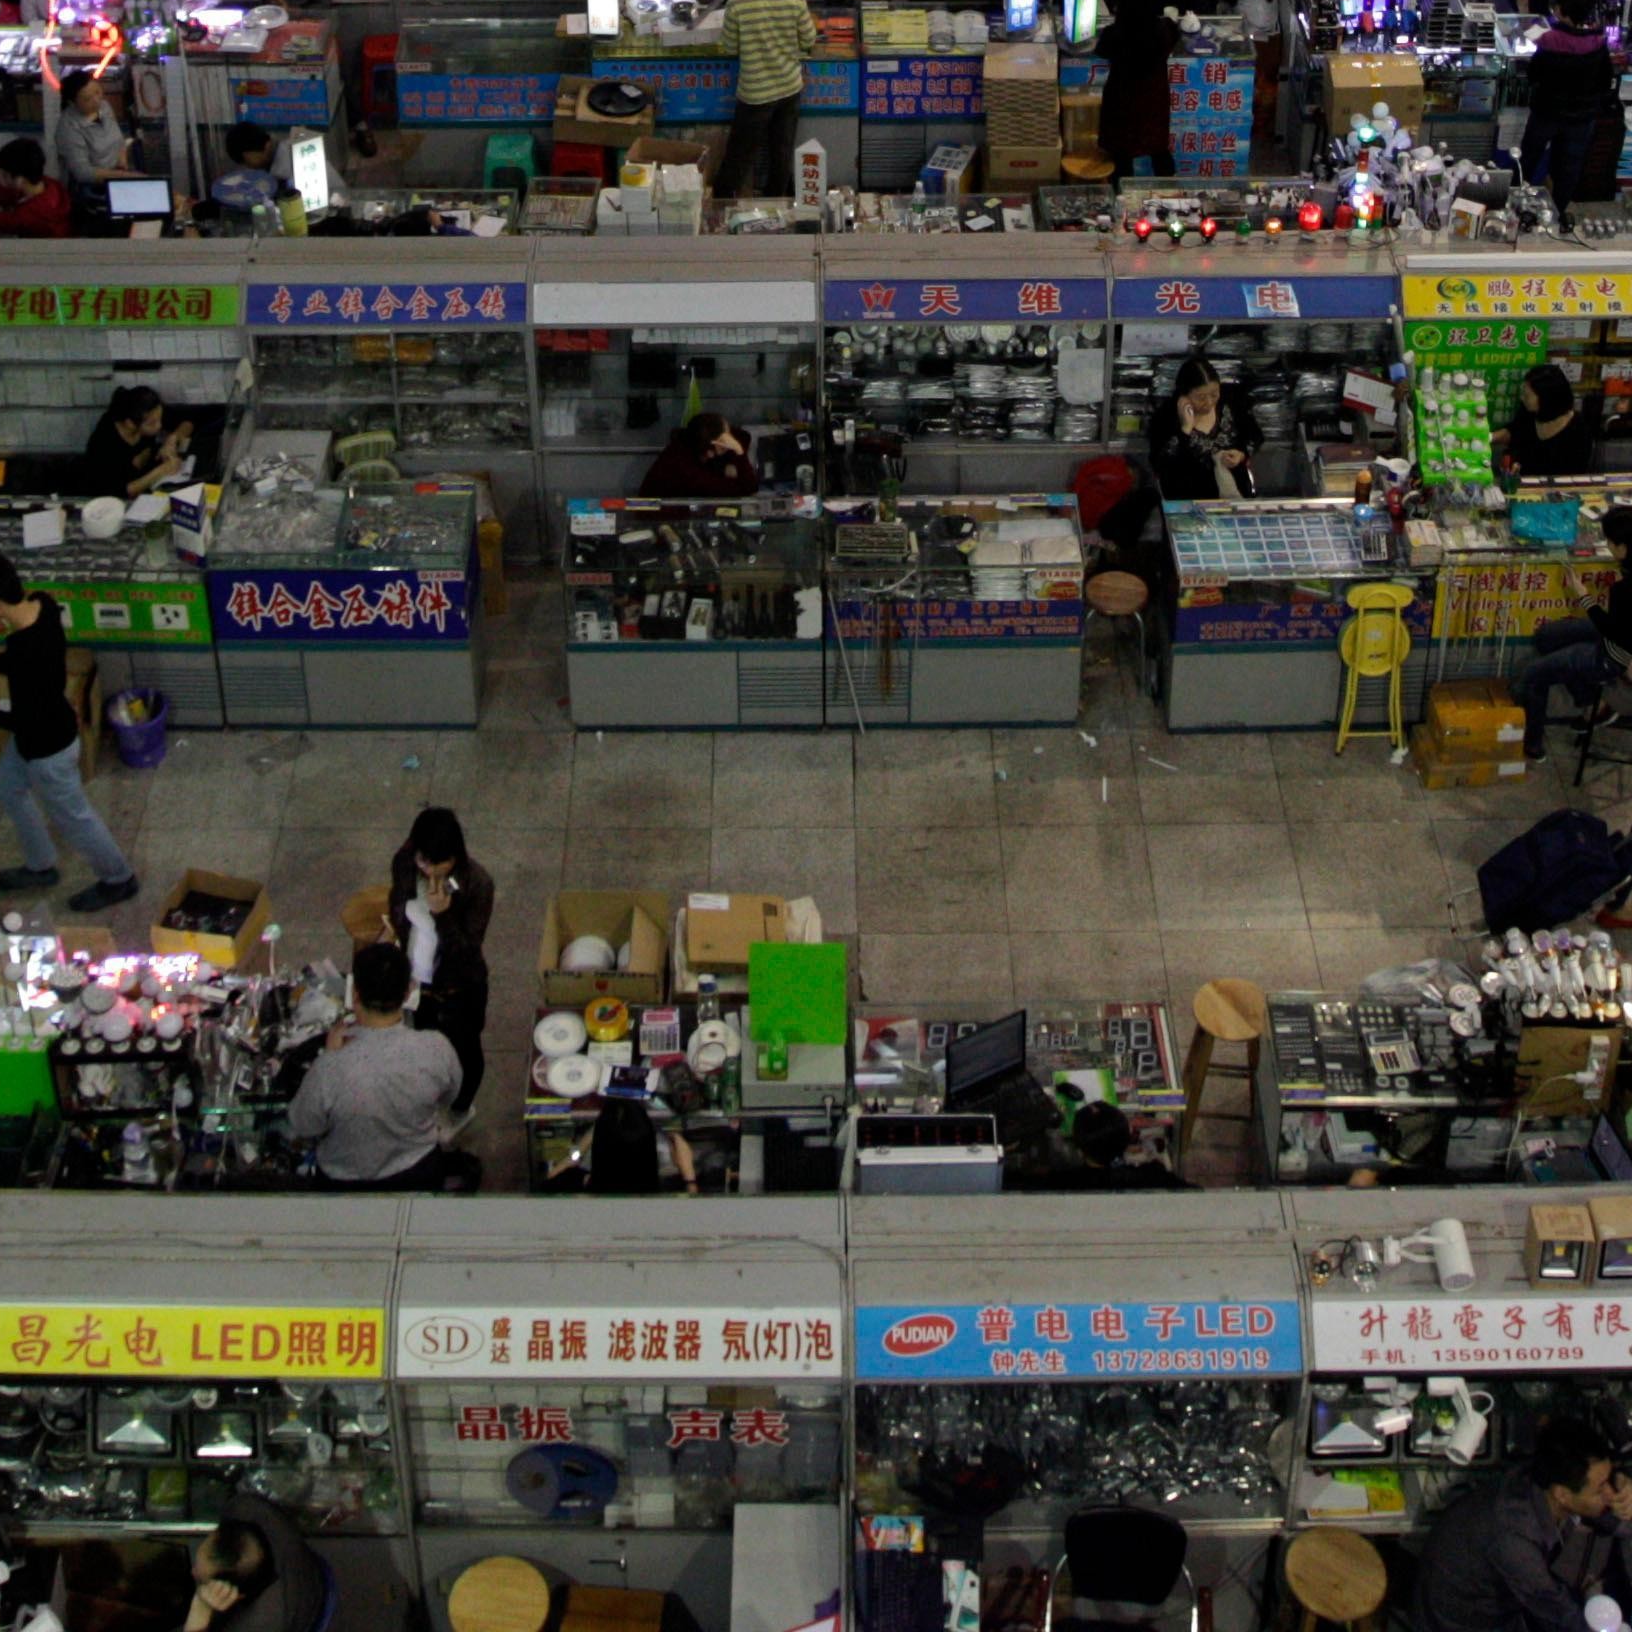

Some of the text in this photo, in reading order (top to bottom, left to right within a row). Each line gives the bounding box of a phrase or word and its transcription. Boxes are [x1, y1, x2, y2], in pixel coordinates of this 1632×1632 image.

[1208, 88, 1243, 112] 电感
[802, 153, 820, 206] 震动马达
[268, 284, 507, 324] 专业锌合金压铸
[226, 579, 453, 633] 锌合金压铸件
[191, 1320, 377, 1367] LED照明
[420, 1324, 468, 1356] SD
[489, 1317, 512, 1365] 盛达
[526, 1318, 587, 1363] 晶振
[608, 1318, 702, 1363] 滤波器
[891, 1323, 950, 1345] PUDIAN
[976, 1305, 1275, 1345] 普电电子LED
[991, 1348, 1270, 1373] 钟先生 13728631919
[1360, 1347, 1585, 1365] 手机: 13590160789
[457, 1405, 789, 1446] 晶振 声表
